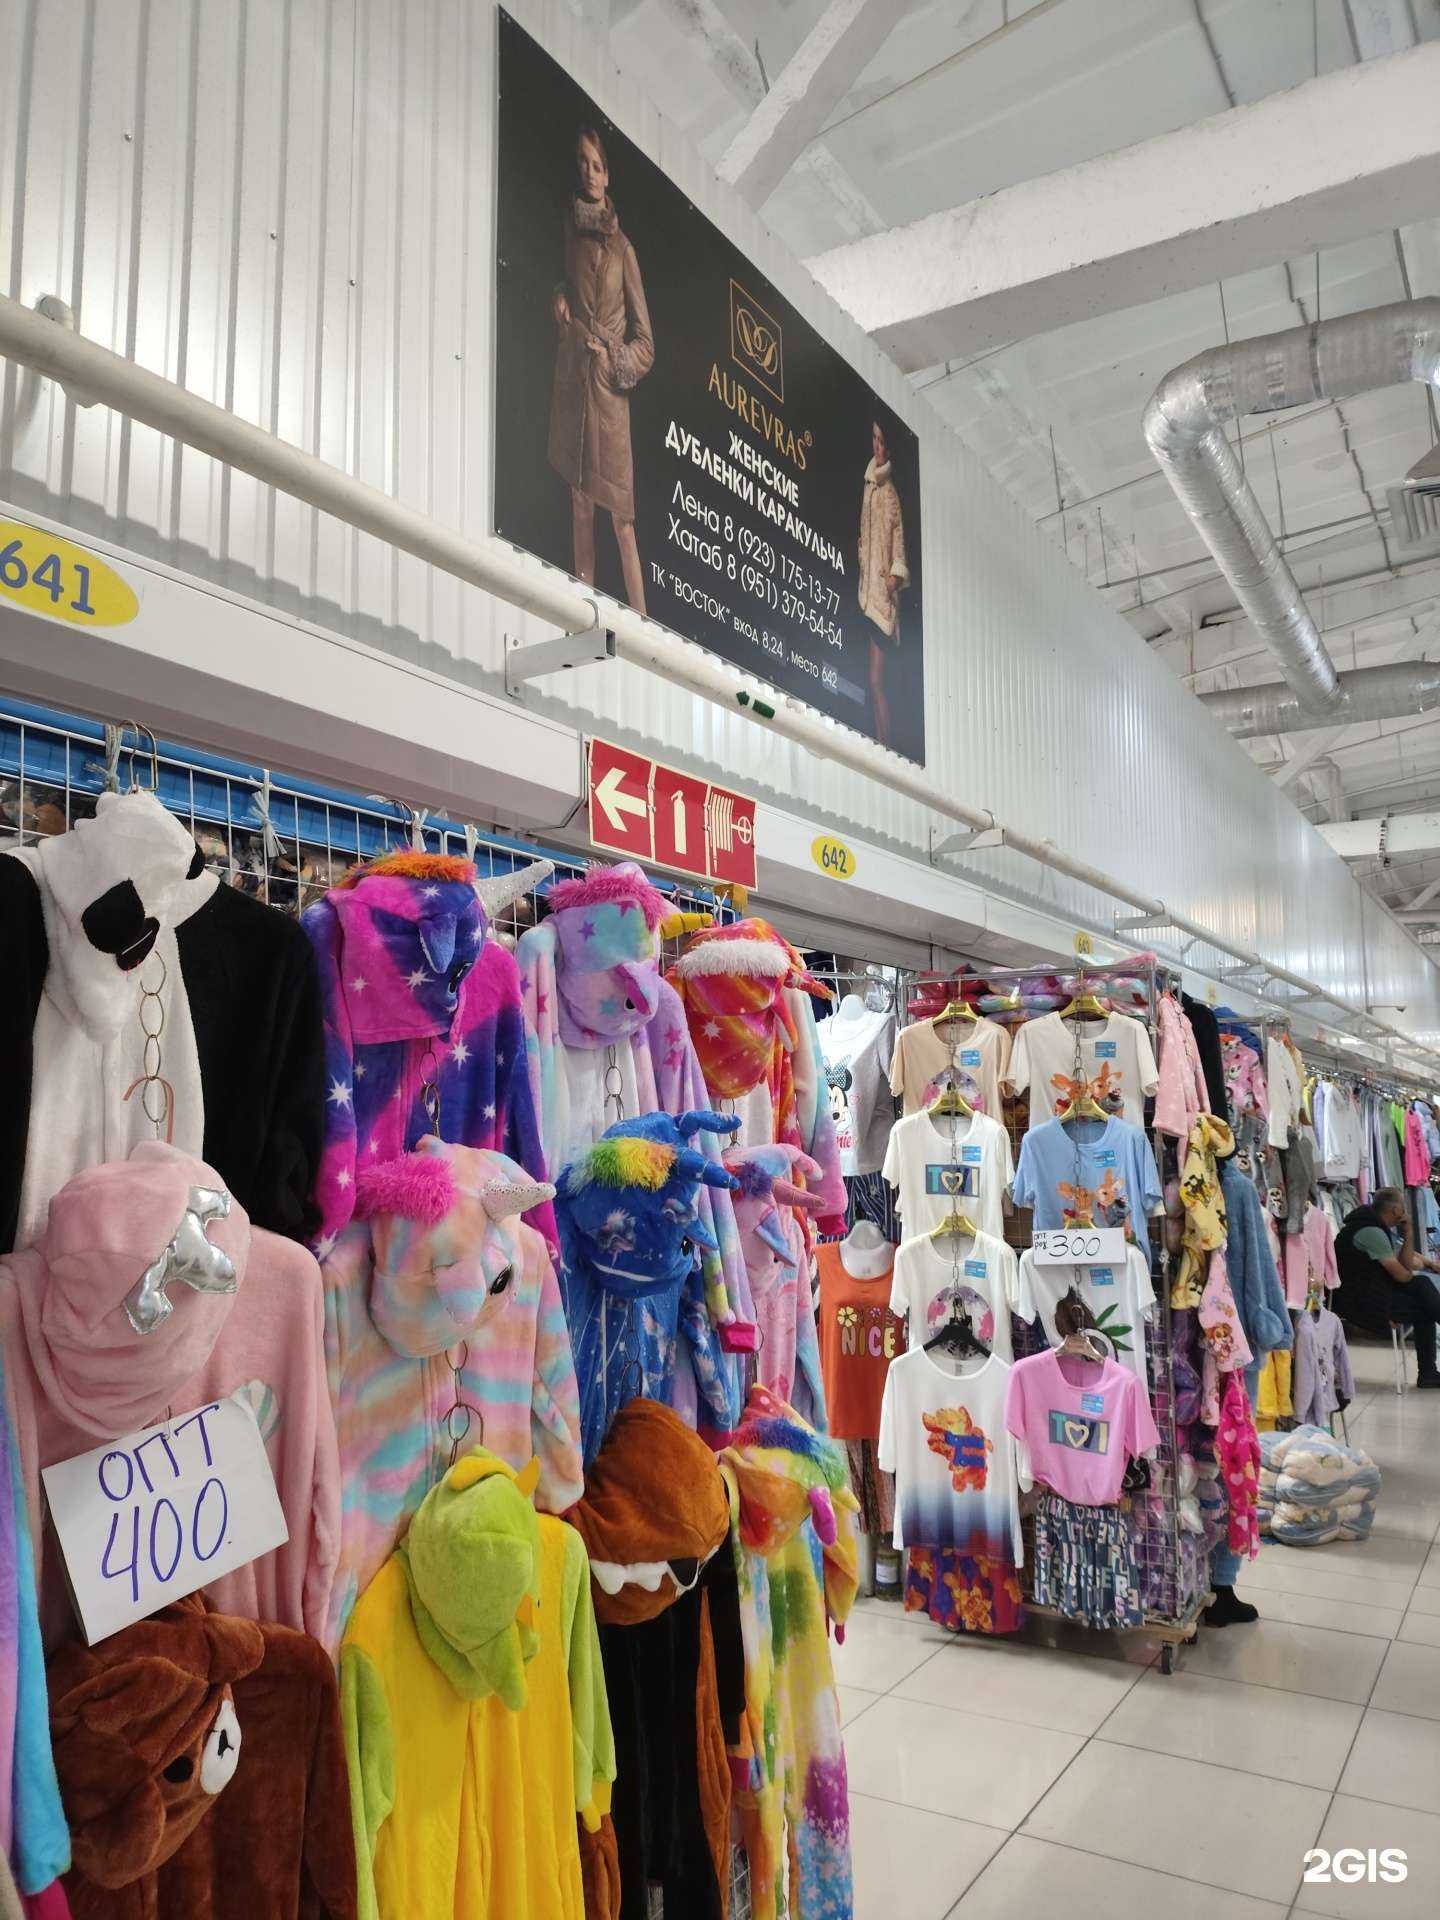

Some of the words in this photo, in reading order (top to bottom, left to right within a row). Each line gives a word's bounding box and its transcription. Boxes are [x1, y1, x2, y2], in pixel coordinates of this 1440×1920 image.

[665, 420, 754, 506] ДУБЛЕНКИ
[758, 487, 845, 575] КАРАКУЛЬЧА
[728, 430, 799, 507] ЖЕНСКИЕ
[0, 540, 95, 615] 641
[668, 512, 722, 571] Хатаб
[727, 553, 736, 580] 8
[741, 564, 778, 610] (951)
[781, 590, 843, 650] 379-54-54
[672, 480, 719, 534] Лена
[724, 515, 734, 542] 8
[738, 527, 775, 574] (923)
[781, 554, 840, 615] 175-13-77
[650, 561, 666, 588] ТК
[733, 616, 759, 645] вход
[821, 666, 837, 689] 642
[822, 844, 847, 873] 642
[1048, 1235, 1100, 1257] 300
[841, 1326, 896, 1358] NICE
[99, 1404, 220, 1502] ОПТ
